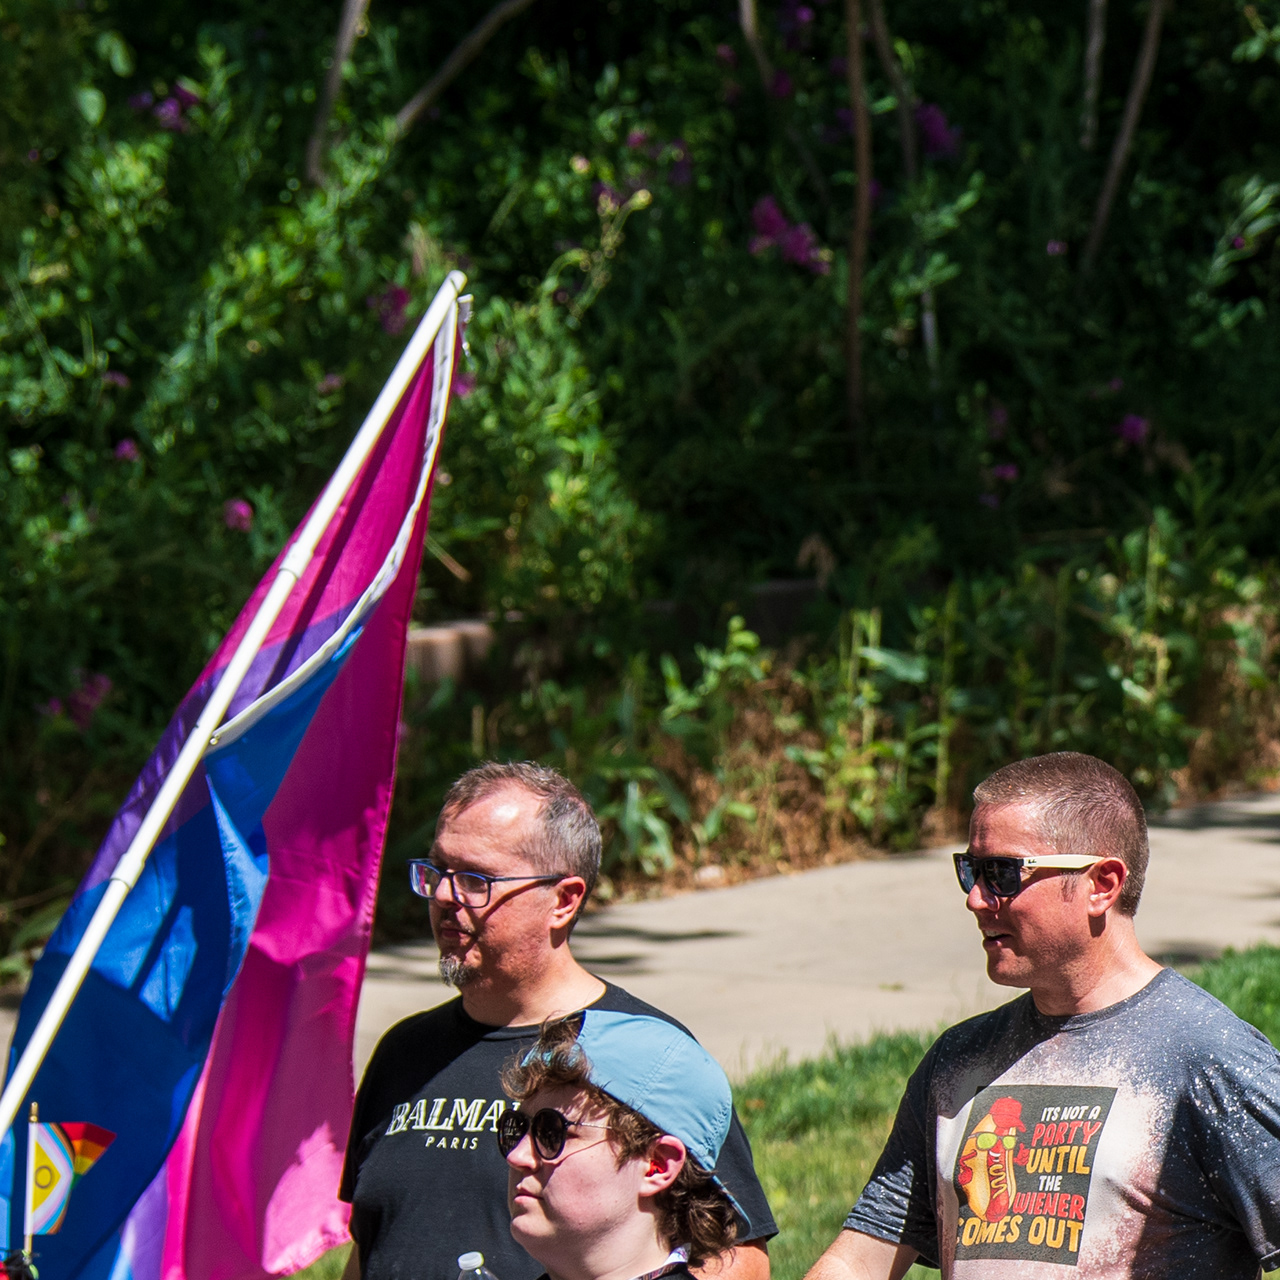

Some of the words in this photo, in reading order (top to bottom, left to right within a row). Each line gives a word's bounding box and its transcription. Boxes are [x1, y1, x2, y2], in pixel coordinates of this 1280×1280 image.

[1060, 1105, 1089, 1121] NOT
[1088, 1105, 1101, 1120] A
[424, 1136, 479, 1150] PARIS
[1031, 1120, 1102, 1147] PARTY
[1026, 1145, 1091, 1175] UNTIL
[1039, 1175, 1063, 1192] THE
[1012, 1191, 1085, 1221] WIENER
[1027, 1216, 1083, 1253] OUT
